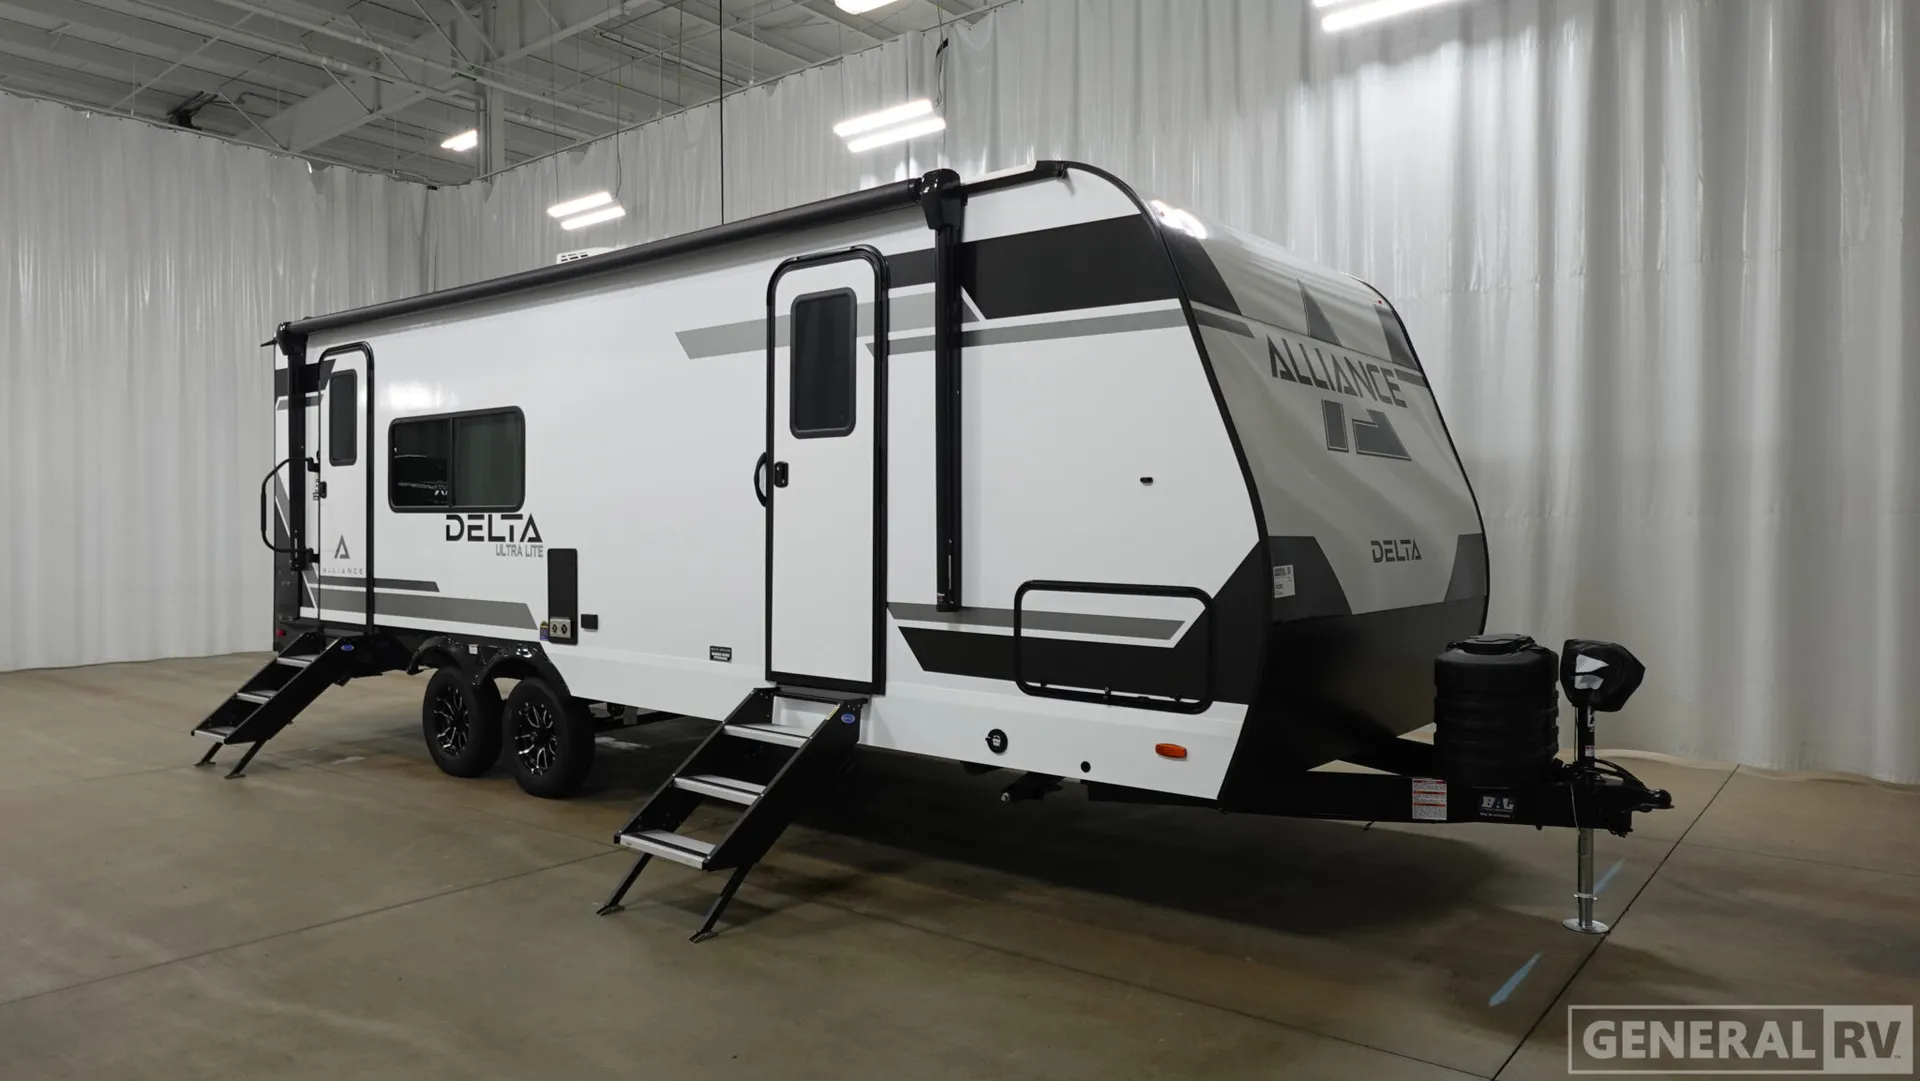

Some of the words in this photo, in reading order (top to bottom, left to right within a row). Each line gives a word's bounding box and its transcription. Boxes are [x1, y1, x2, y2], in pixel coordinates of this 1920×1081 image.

[1267, 334, 1408, 408] ALLIANCE
[446, 513, 543, 543] DELTA
[496, 544, 523, 557] ULTRA
[525, 545, 544, 558] LITE
[1371, 538, 1422, 563] DELTA
